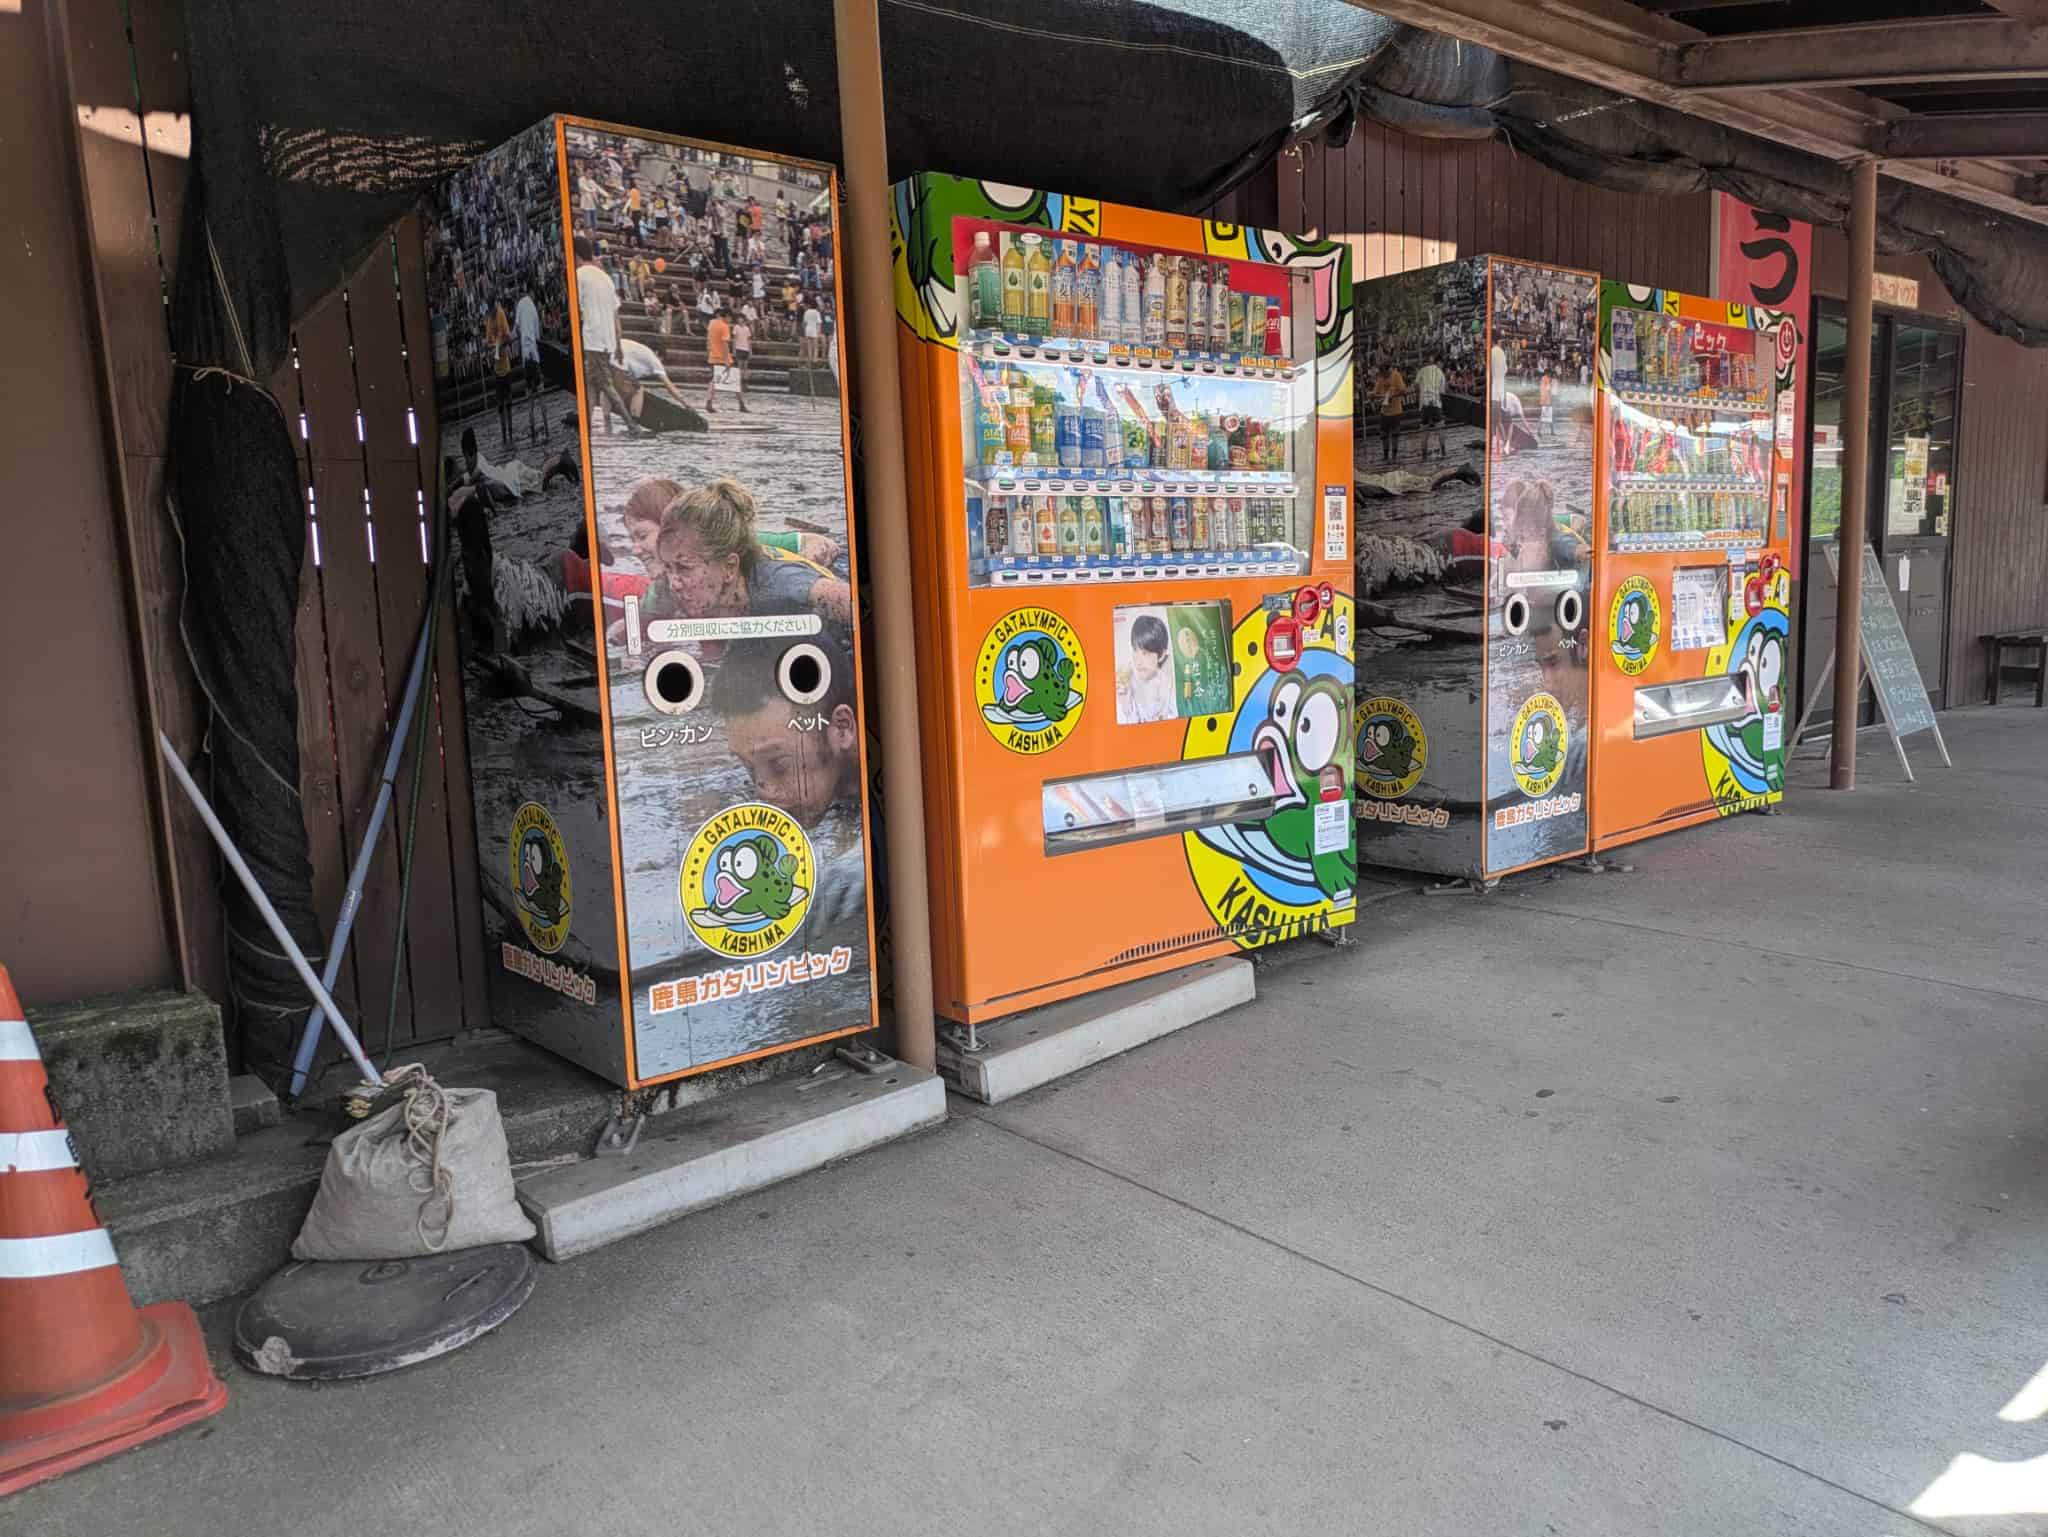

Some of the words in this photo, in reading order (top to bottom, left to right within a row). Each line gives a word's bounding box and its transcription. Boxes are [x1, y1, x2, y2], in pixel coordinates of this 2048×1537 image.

[666, 619, 807, 638] 分別回収にご協力ください
[995, 610, 1069, 643] GATALYMPIC
[1360, 700, 1413, 724] GATALYMPIC
[1007, 726, 1063, 751] KASHIMA
[1365, 778, 1405, 794] KASHIMA
[517, 807, 557, 845] GATALYMPIC
[703, 809, 791, 844] GATALYMPIC
[720, 923, 785, 953] KASHIMA
[651, 948, 851, 1013] 鹿島ガタリンピック
